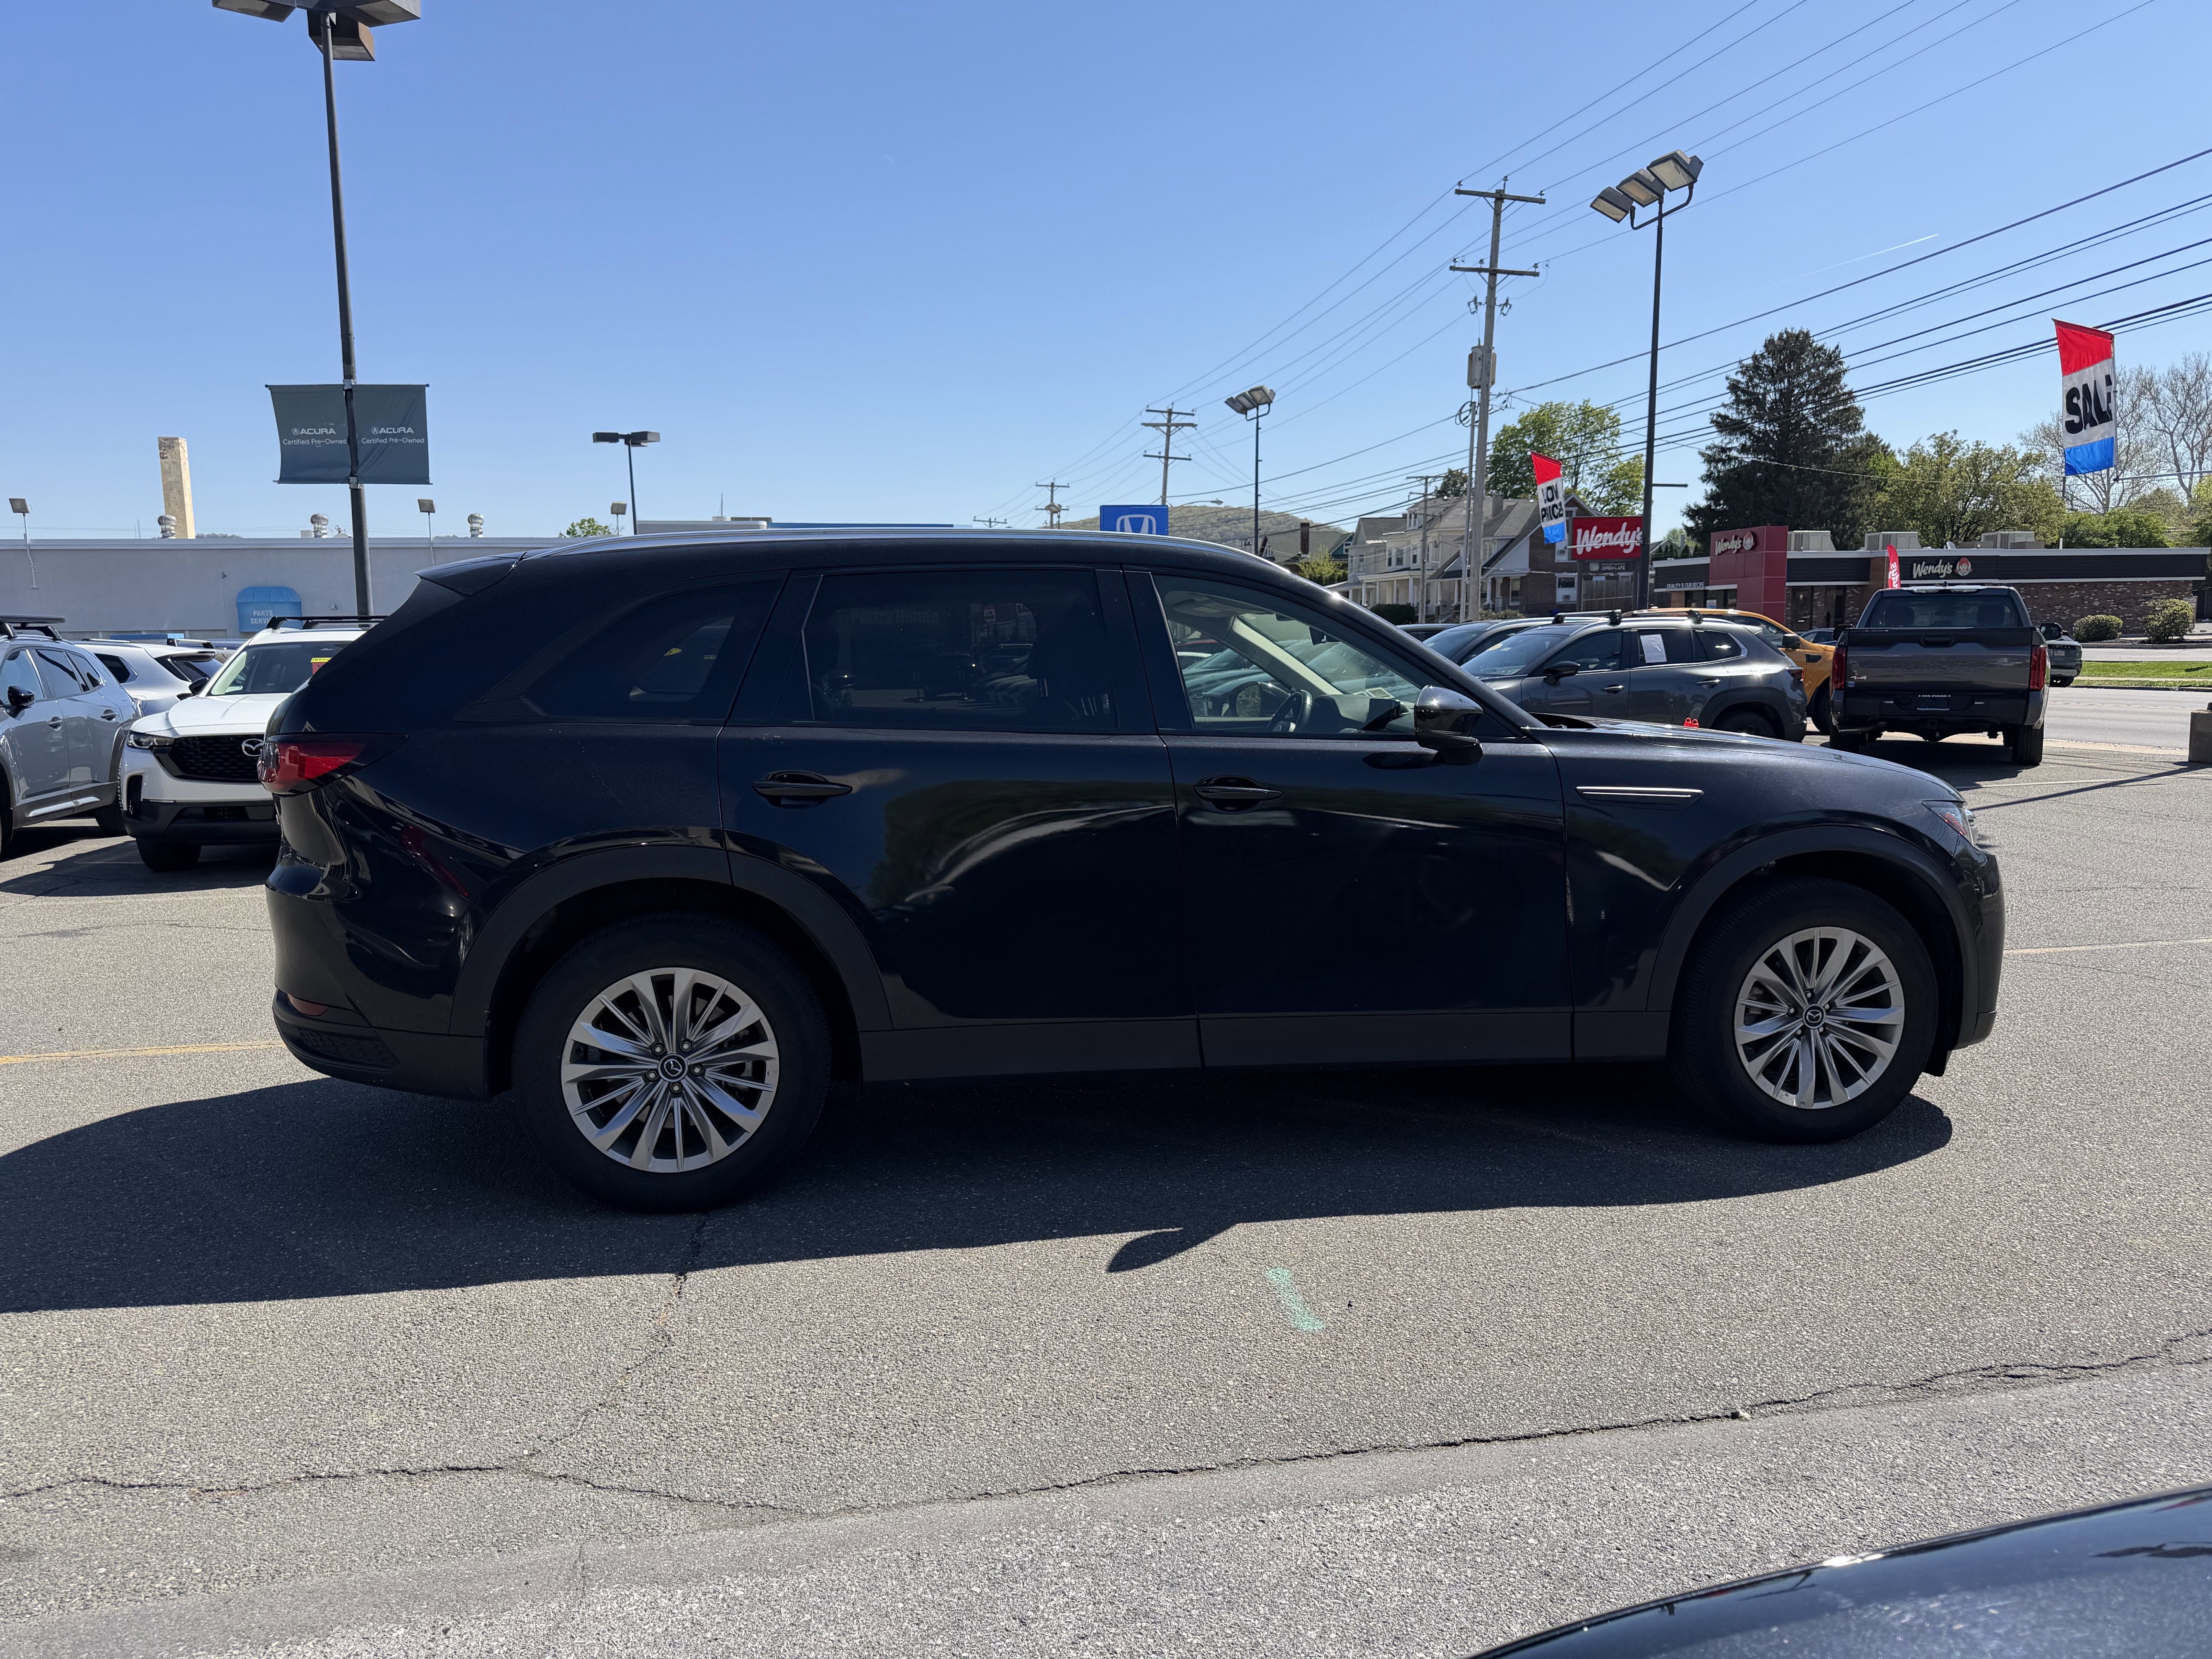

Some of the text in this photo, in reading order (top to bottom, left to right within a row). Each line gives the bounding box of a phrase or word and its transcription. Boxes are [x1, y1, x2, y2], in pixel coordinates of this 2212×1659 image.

[1577, 522, 1642, 555] Wendy's
[1715, 534, 1742, 555] Wendy's
[1913, 559, 1953, 579] Wendy's
